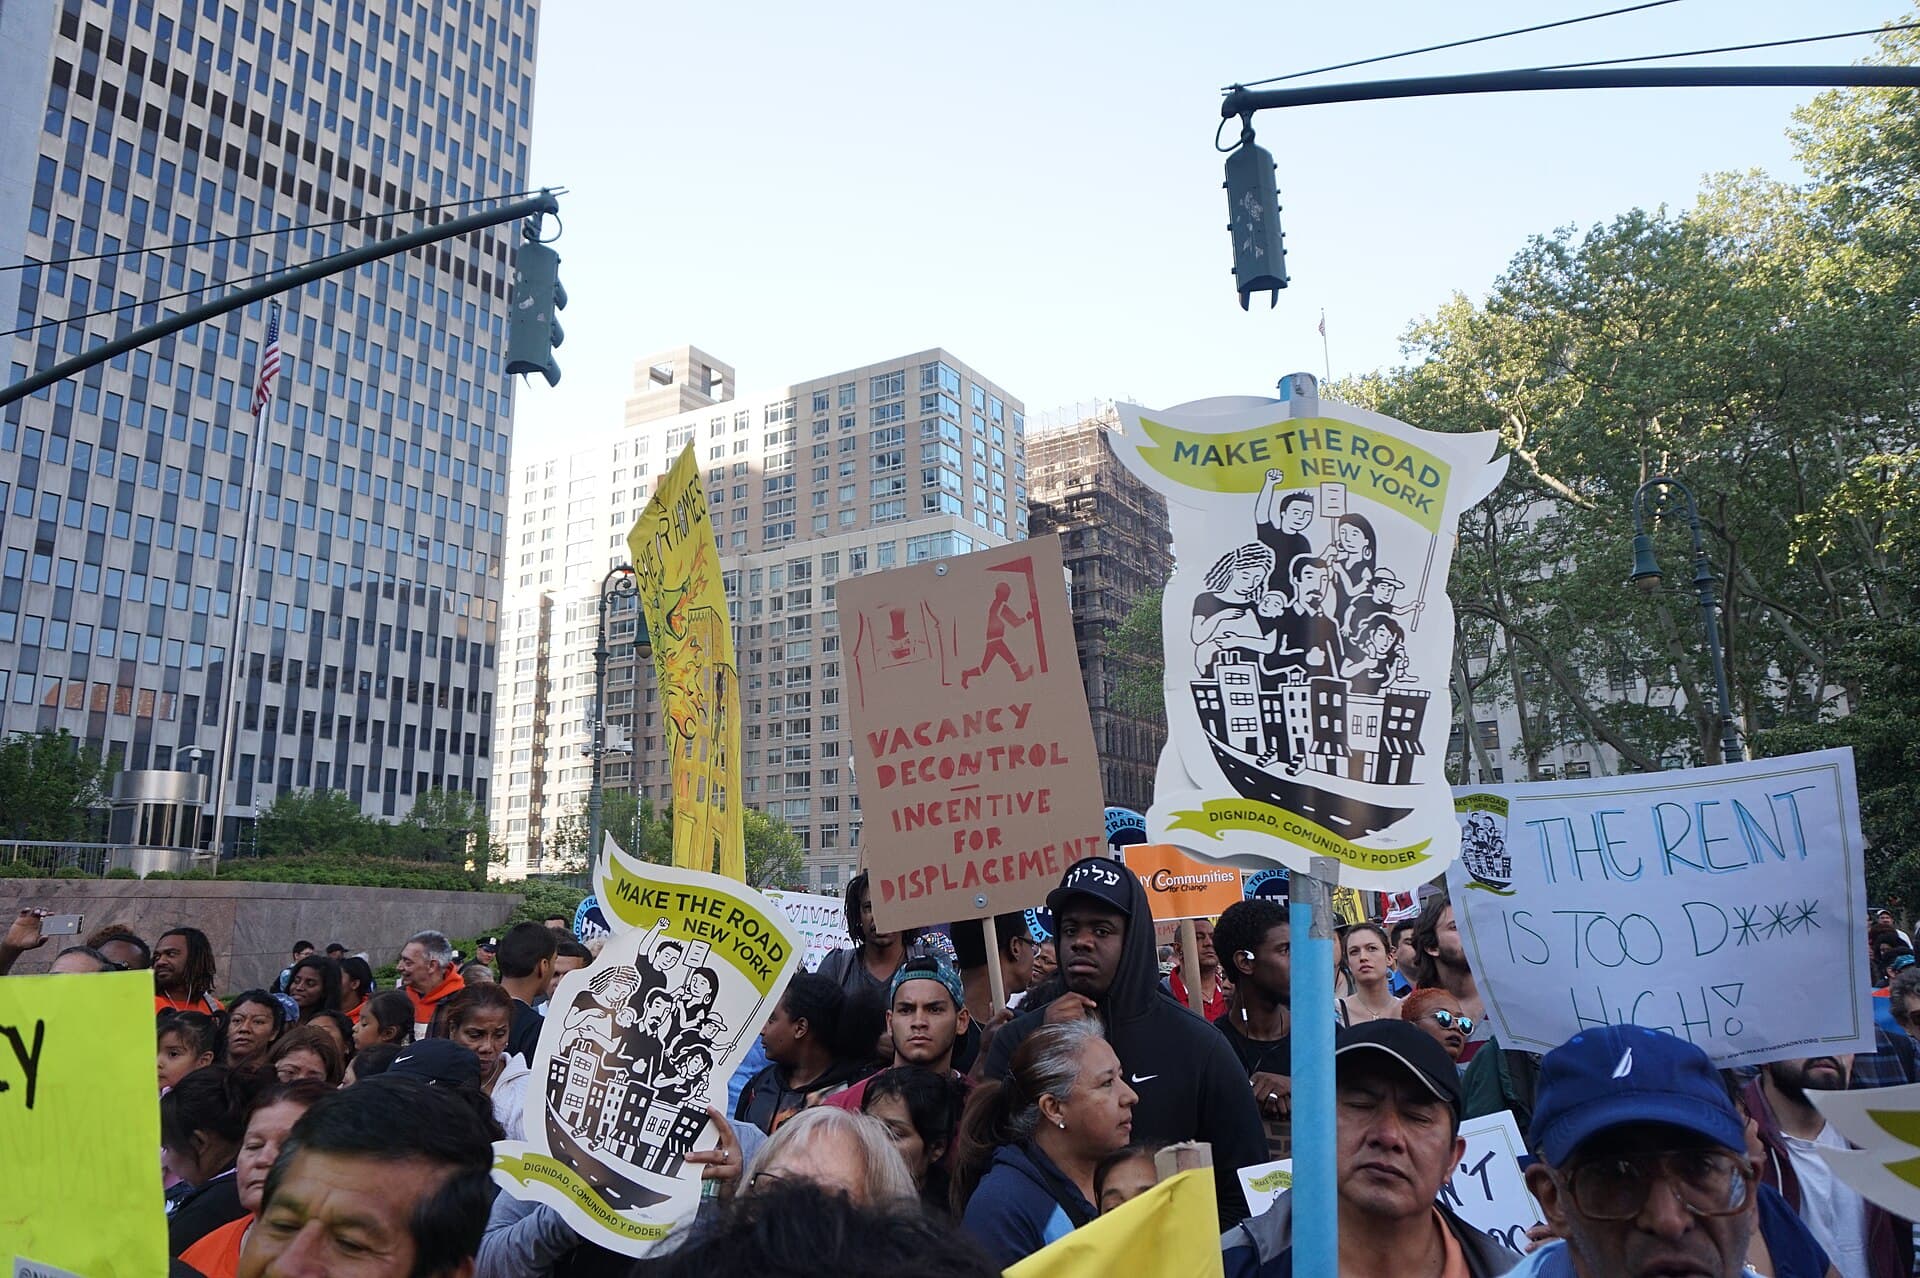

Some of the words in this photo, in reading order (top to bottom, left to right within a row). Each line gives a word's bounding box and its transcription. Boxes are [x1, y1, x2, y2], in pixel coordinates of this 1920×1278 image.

[1173, 438, 1271, 467] MAKE
[1276, 428, 1343, 455] THE
[1350, 434, 1441, 489] ROAD
[1301, 457, 1361, 481] NEW
[1368, 469, 1435, 514] YORK
[671, 473, 706, 546] HOMES
[867, 702, 1032, 758] VACANCY
[877, 742, 1069, 789] DECONTROL
[891, 788, 1052, 833] INCENTIVE
[1105, 817, 1145, 834] TRADE
[1209, 810, 1279, 829] DIGNIDAD,
[1282, 820, 1358, 860] COMUNIDAD
[1360, 852, 1368, 863] Y
[1371, 850, 1417, 866] PODER
[1525, 808, 1644, 884] THE
[1652, 785, 1817, 877] RENT
[953, 827, 1003, 854] FOR
[880, 836, 1100, 904] DISPLACEMENT
[1152, 868, 1235, 892] Communities
[1169, 884, 1180, 893] for
[1181, 883, 1208, 893] Change
[1249, 869, 1290, 887] TRADES
[615, 878, 670, 910] MAKE
[676, 893, 726, 919] THE
[726, 908, 784, 963] ROAD
[1502, 909, 1550, 965] IS
[1552, 910, 1663, 968] TOO
[683, 917, 730, 944] NEW
[732, 937, 772, 983] YORK
[523, 1162, 570, 1188] DIGNIDAD,
[571, 1185, 618, 1226] COMUNIDAD
[620, 1222, 627, 1230] Y
[628, 1224, 662, 1237] PODER
